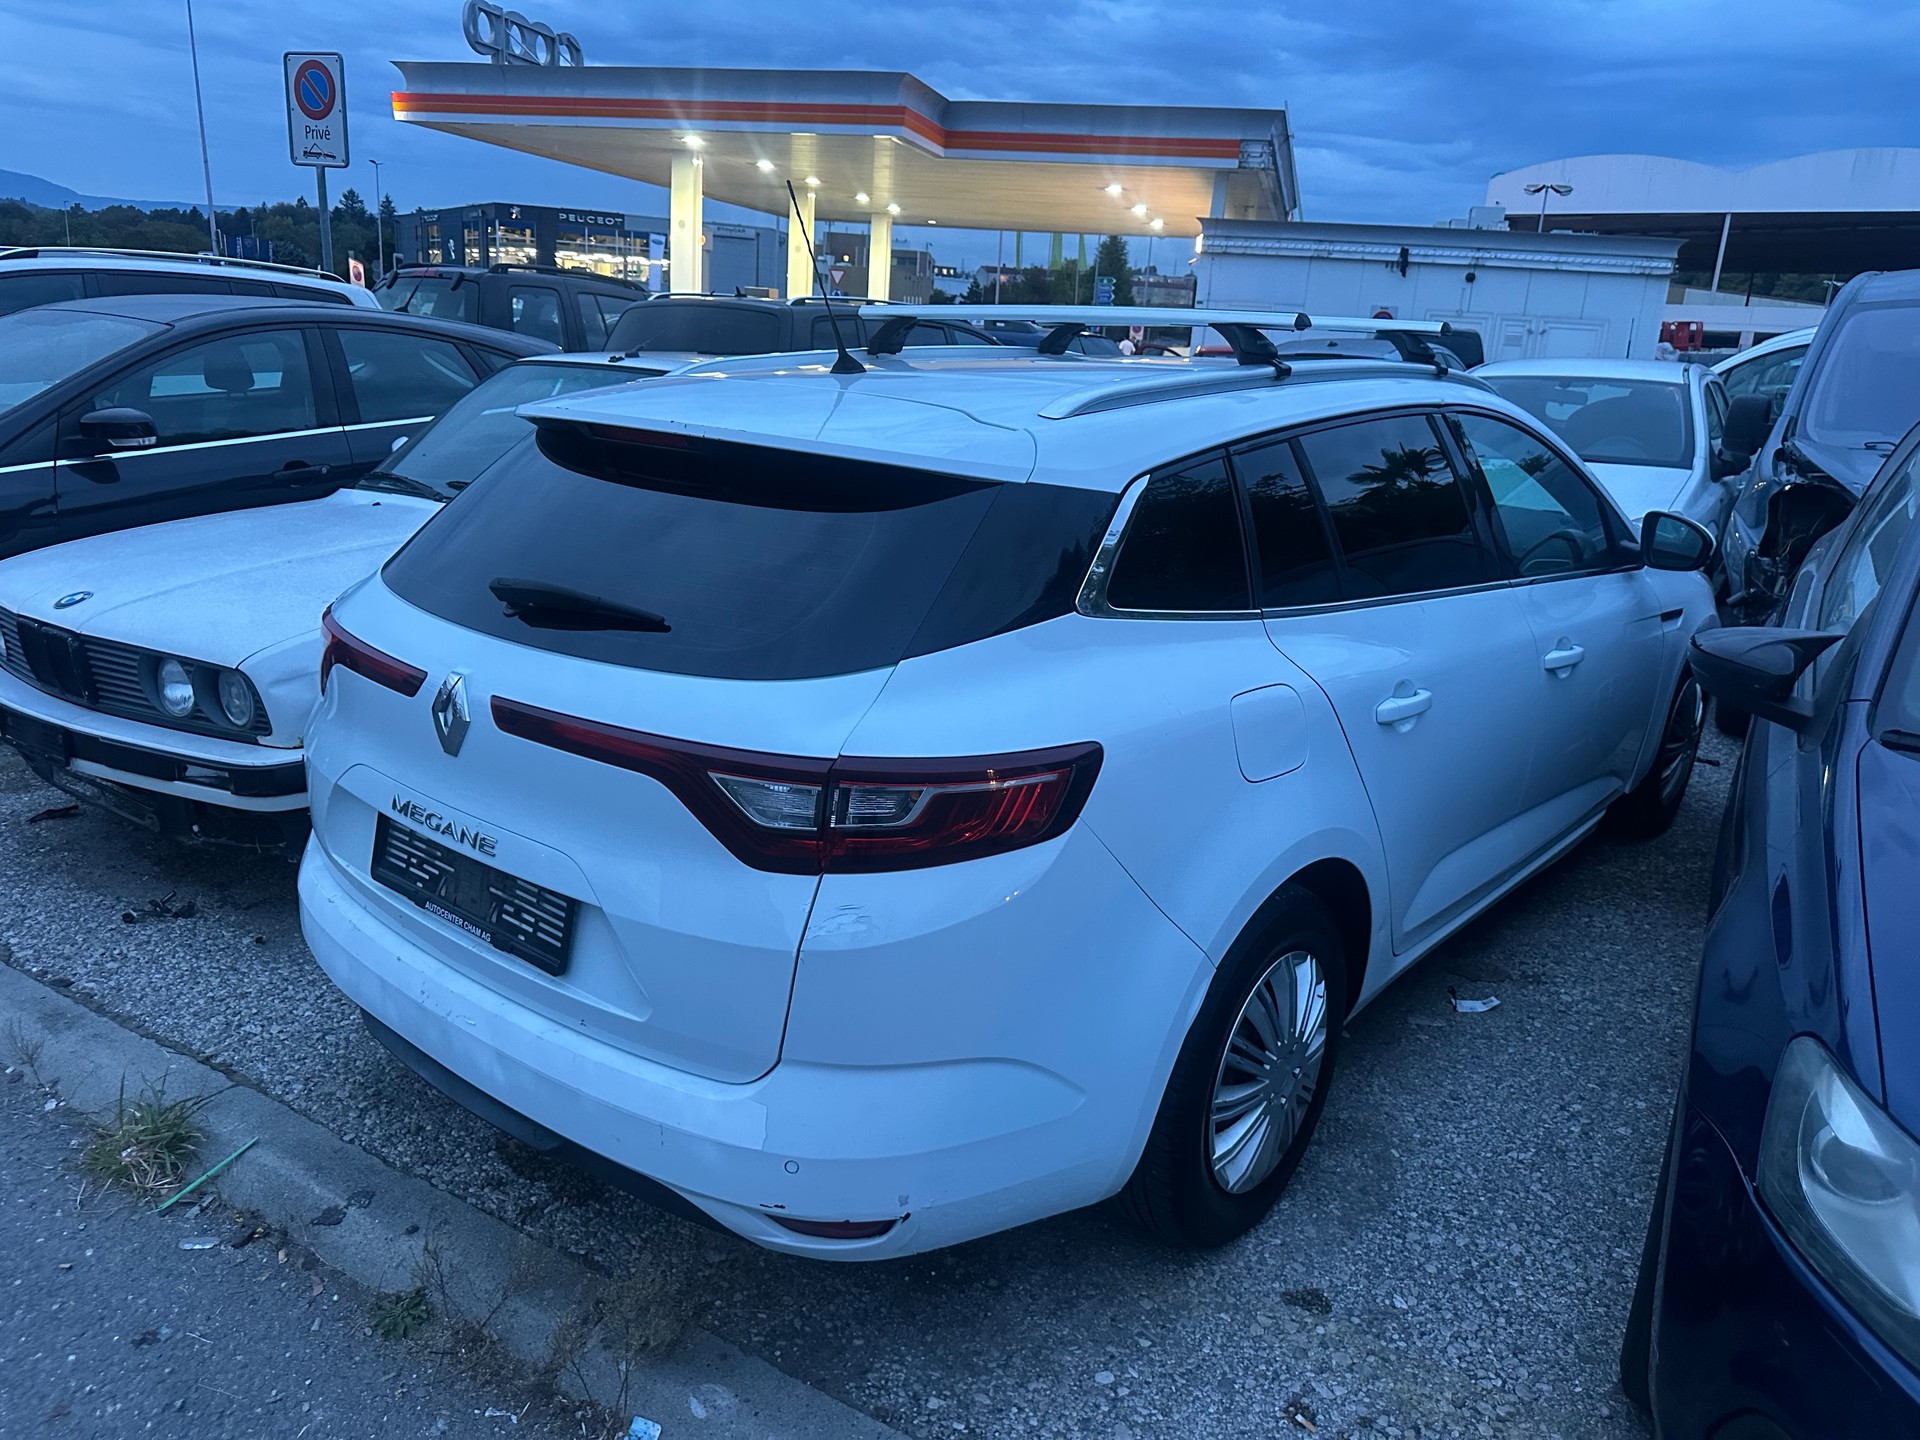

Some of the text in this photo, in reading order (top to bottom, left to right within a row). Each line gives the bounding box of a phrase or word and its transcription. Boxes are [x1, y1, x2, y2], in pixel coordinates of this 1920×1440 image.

[304, 125, 331, 140] Privé
[558, 212, 623, 226] PEUGEOT
[391, 793, 499, 857] MEGANE
[424, 901, 491, 942] AUTOCENTER CHAM AG
